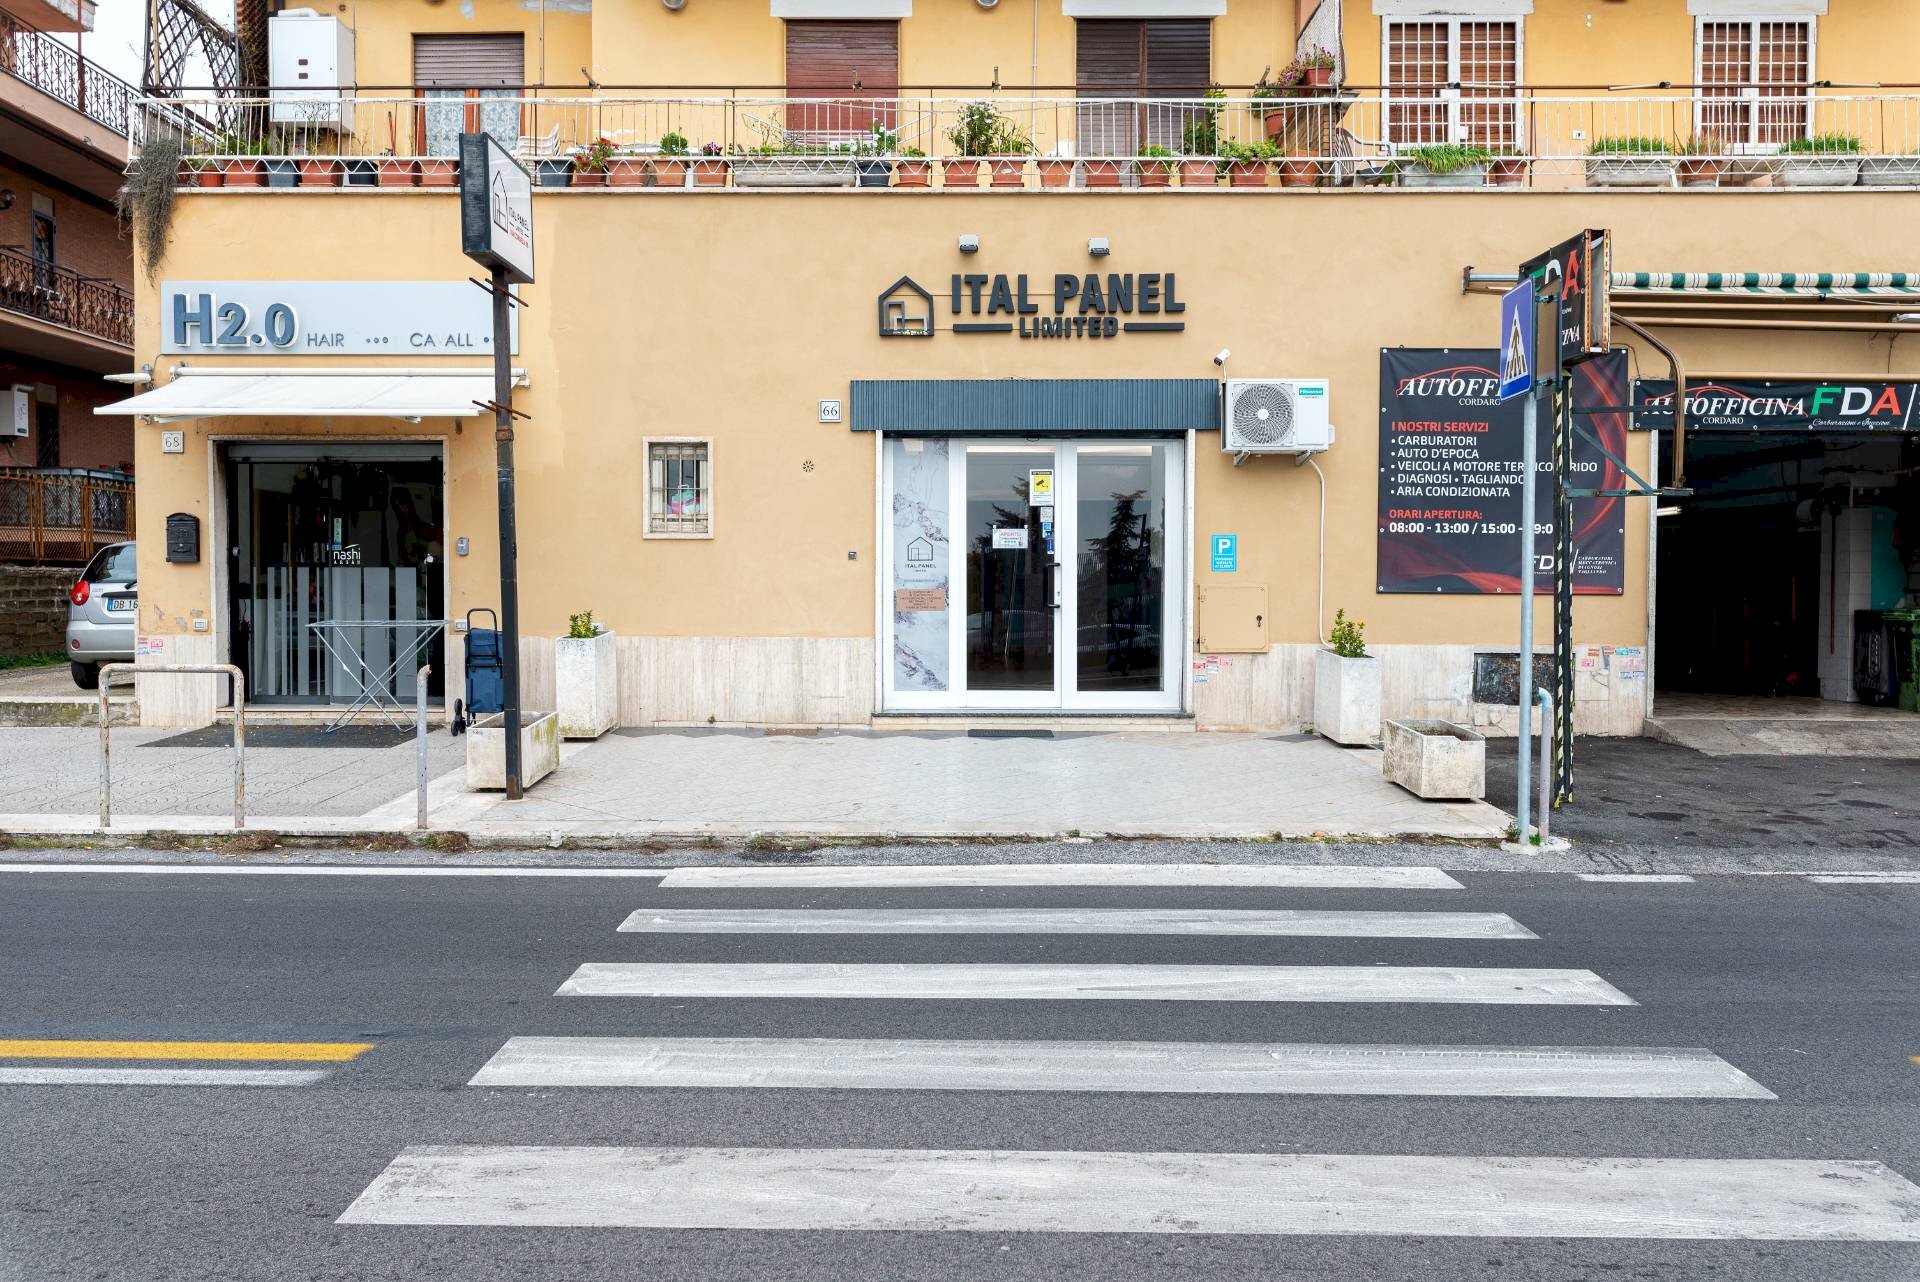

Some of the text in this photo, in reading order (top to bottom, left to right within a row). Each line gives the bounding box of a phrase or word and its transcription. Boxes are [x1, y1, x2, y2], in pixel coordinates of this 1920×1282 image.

[951, 273, 1185, 314] ITAL PANEL
[173, 294, 298, 348] H2.0
[307, 333, 344, 347] HAIR
[1019, 316, 1118, 338] LIMITED
[1811, 387, 1901, 415] FDA
[822, 405, 838, 416] 66
[1702, 416, 1744, 425] CORDARO
[1391, 422, 1489, 432] I NOSTRI SERVIZI
[165, 436, 180, 449] 68
[1397, 436, 1477, 446] CARBURATORI
[1397, 449, 1480, 459] AUTO D'EPOCA
[1397, 461, 1598, 472] VEICOLI A MOTORE TERICO RIDO
[1397, 474, 1452, 484] DIAGNOSI
[1396, 487, 1511, 497] ARIA CONDIZIONATA
[1389, 509, 1483, 520] ORARI APERTURA:
[1389, 523, 1424, 533] 08:00
[1435, 523, 1469, 533] 13:00
[1481, 523, 1516, 534] 15:00
[1534, 523, 1554, 534] 9:0
[1218, 538, 1231, 554] P
[333, 548, 361, 560] nashi
[114, 600, 125, 609] DB
